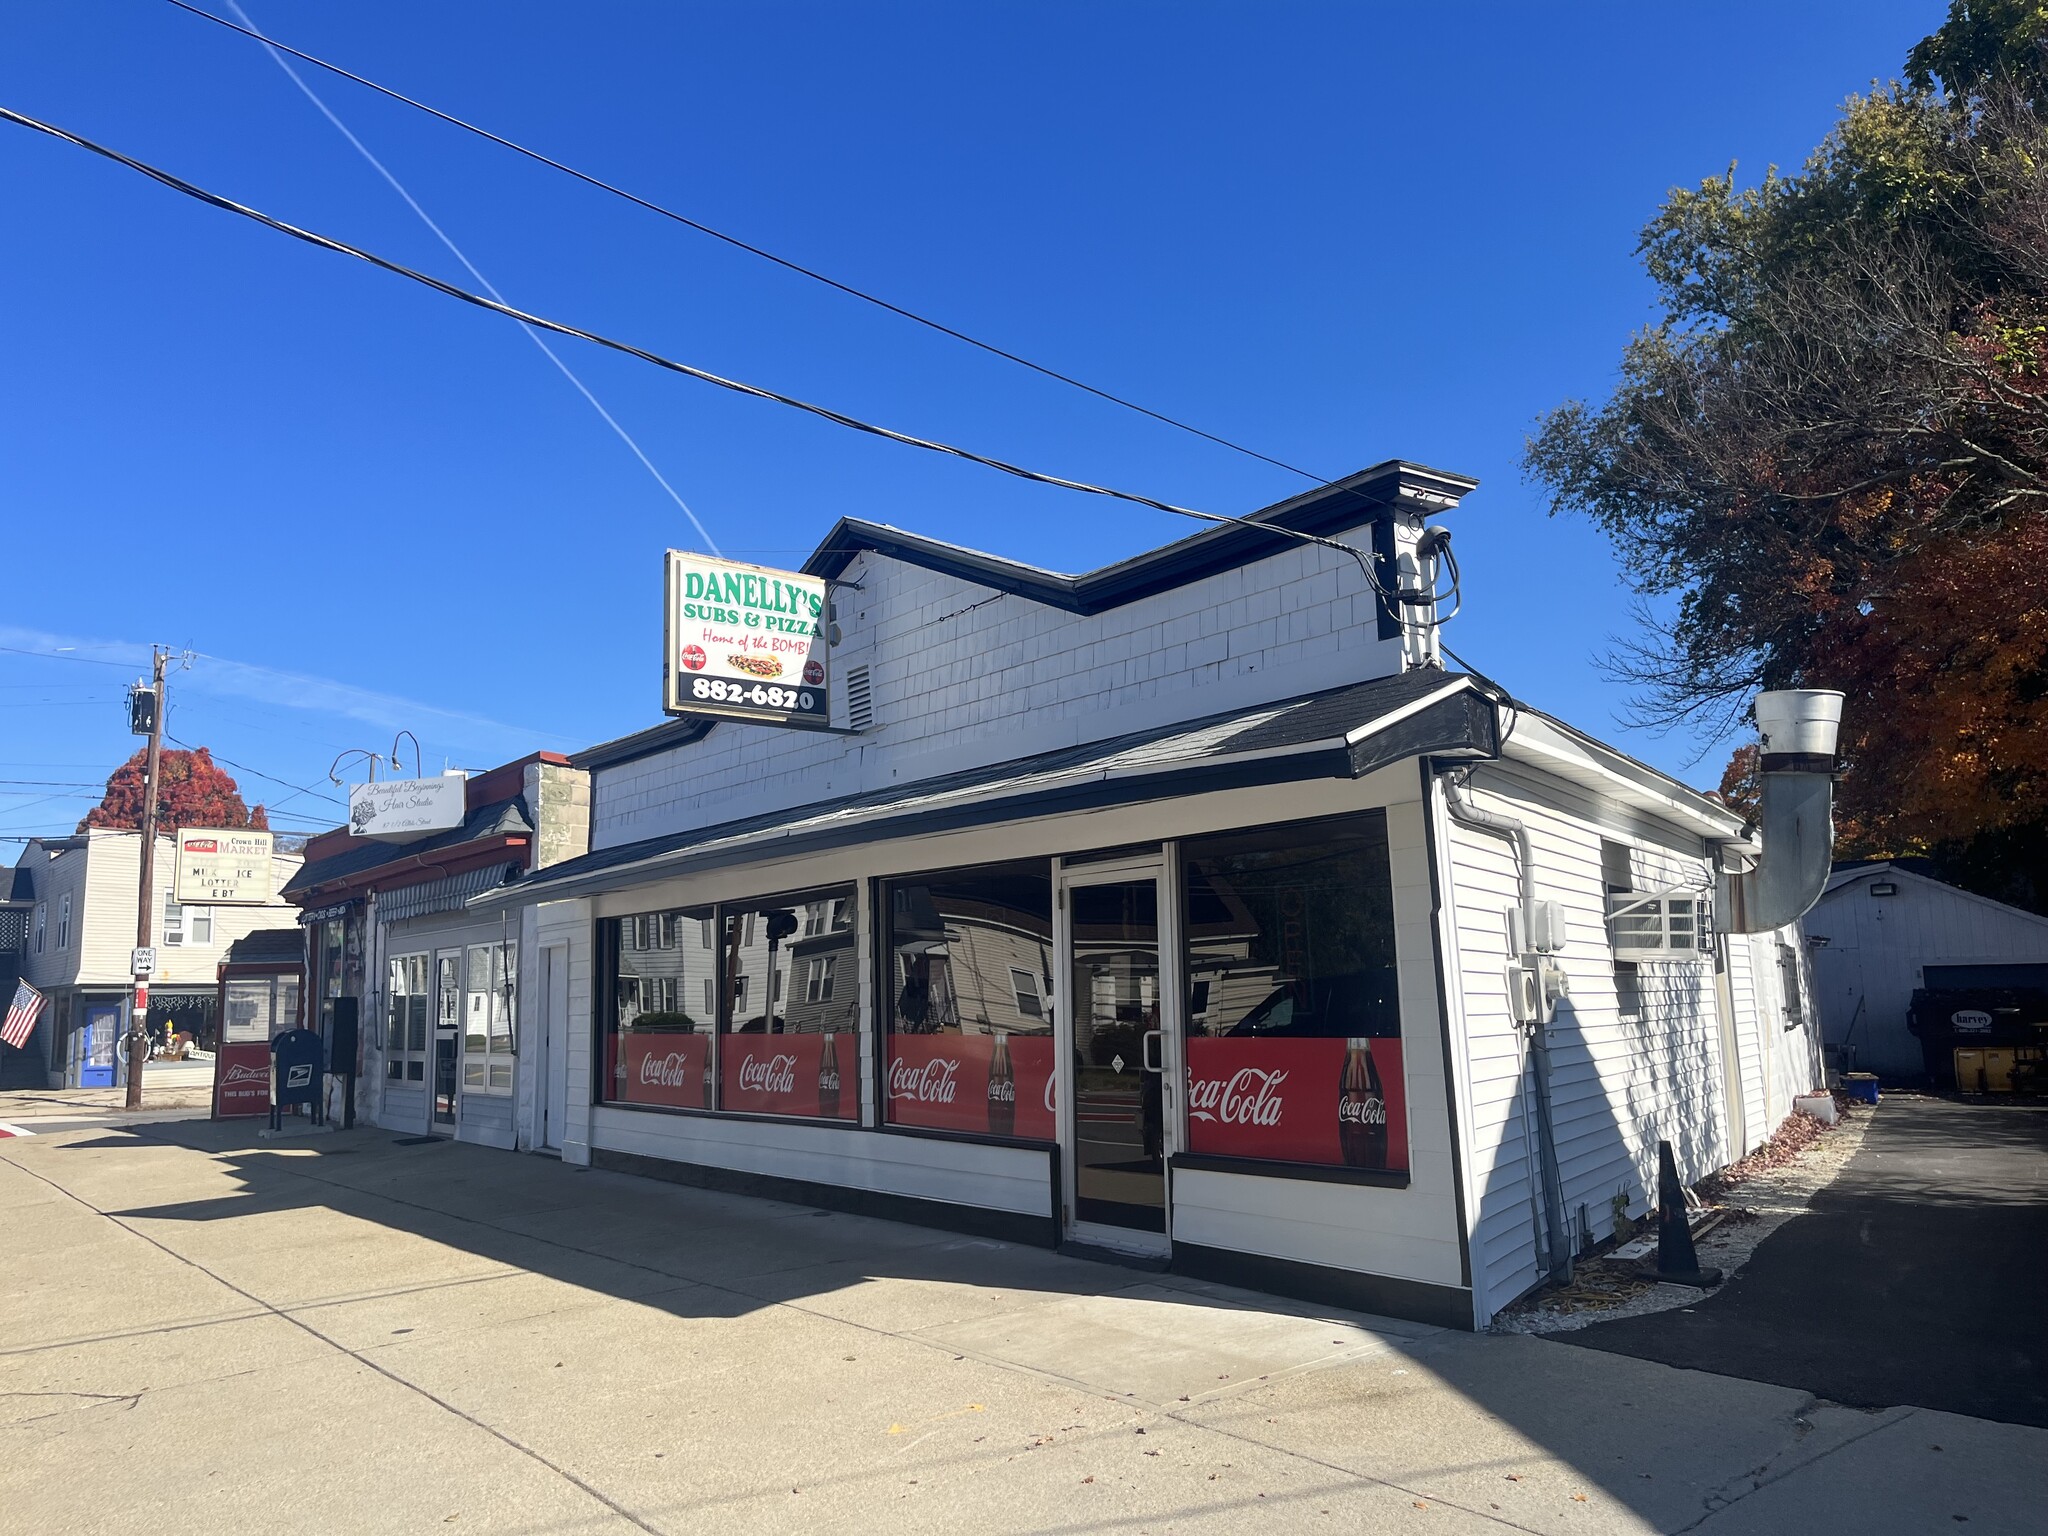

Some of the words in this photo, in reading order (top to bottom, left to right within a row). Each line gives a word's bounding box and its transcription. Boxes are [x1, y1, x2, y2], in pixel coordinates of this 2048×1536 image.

[685, 572, 822, 618] DANELLY'S
[684, 603, 739, 624] SUBS
[744, 612, 760, 627] &
[766, 616, 823, 637] PIZZA
[703, 628, 734, 645] Home
[738, 634, 749, 651] of
[752, 636, 768, 649] the
[772, 640, 809, 655] BOMB!
[692, 678, 815, 709] 882-6820
[404, 780, 444, 793] Beginnings
[220, 842, 267, 855] MARKET
[237, 870, 252, 878] ICE
[1956, 1014, 1988, 1027] harvey
[640, 1051, 687, 1087] Coca-Cola
[739, 1054, 798, 1093] Coca-Cola
[888, 1057, 960, 1103] Coca-Cola
[988, 1080, 1014, 1102] Coca-Cola
[1187, 1066, 1289, 1126] oca-Cola
[1339, 1096, 1386, 1124] Coca-Cola
